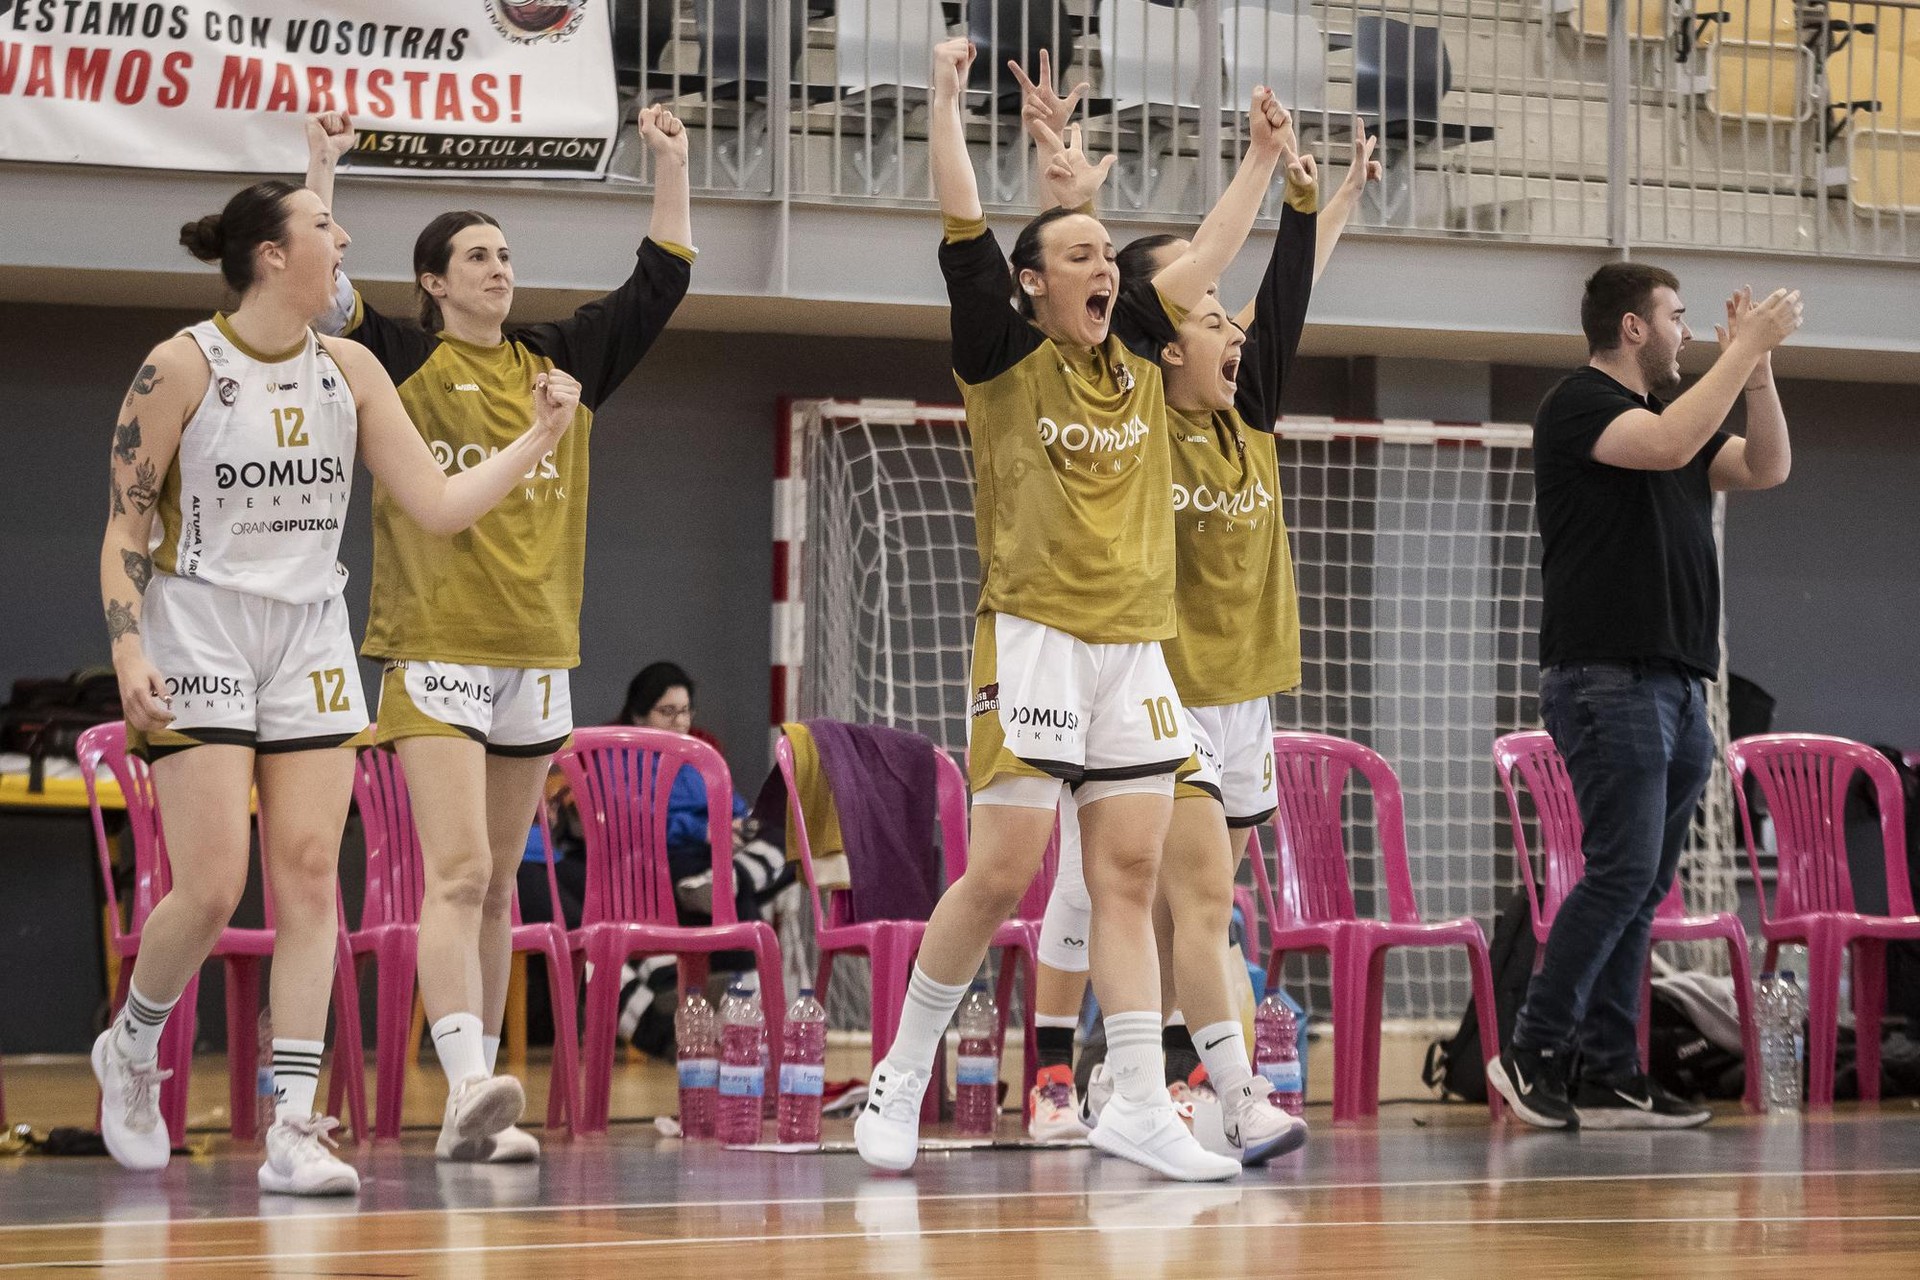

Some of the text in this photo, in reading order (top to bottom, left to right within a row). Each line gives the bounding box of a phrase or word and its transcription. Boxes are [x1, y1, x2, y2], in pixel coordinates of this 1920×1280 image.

[12, 0, 190, 39] ESTAMOS
[204, 10, 272, 49] CON
[285, 18, 469, 62] VOSOTRAS
[0, 41, 523, 123] VAMOS MARISTAS!
[440, 137, 601, 158] ROTULACIÓN
[270, 407, 309, 448] 12
[1038, 414, 1150, 453] DOMUSA
[215, 456, 345, 489] DOMUSA
[216, 491, 346, 509] TEKNIK
[151, 676, 244, 698] OMUSA
[307, 668, 350, 713] 12
[424, 675, 492, 704] DOMUS
[1142, 696, 1178, 741] 10
[1262, 752, 1272, 793] 9
